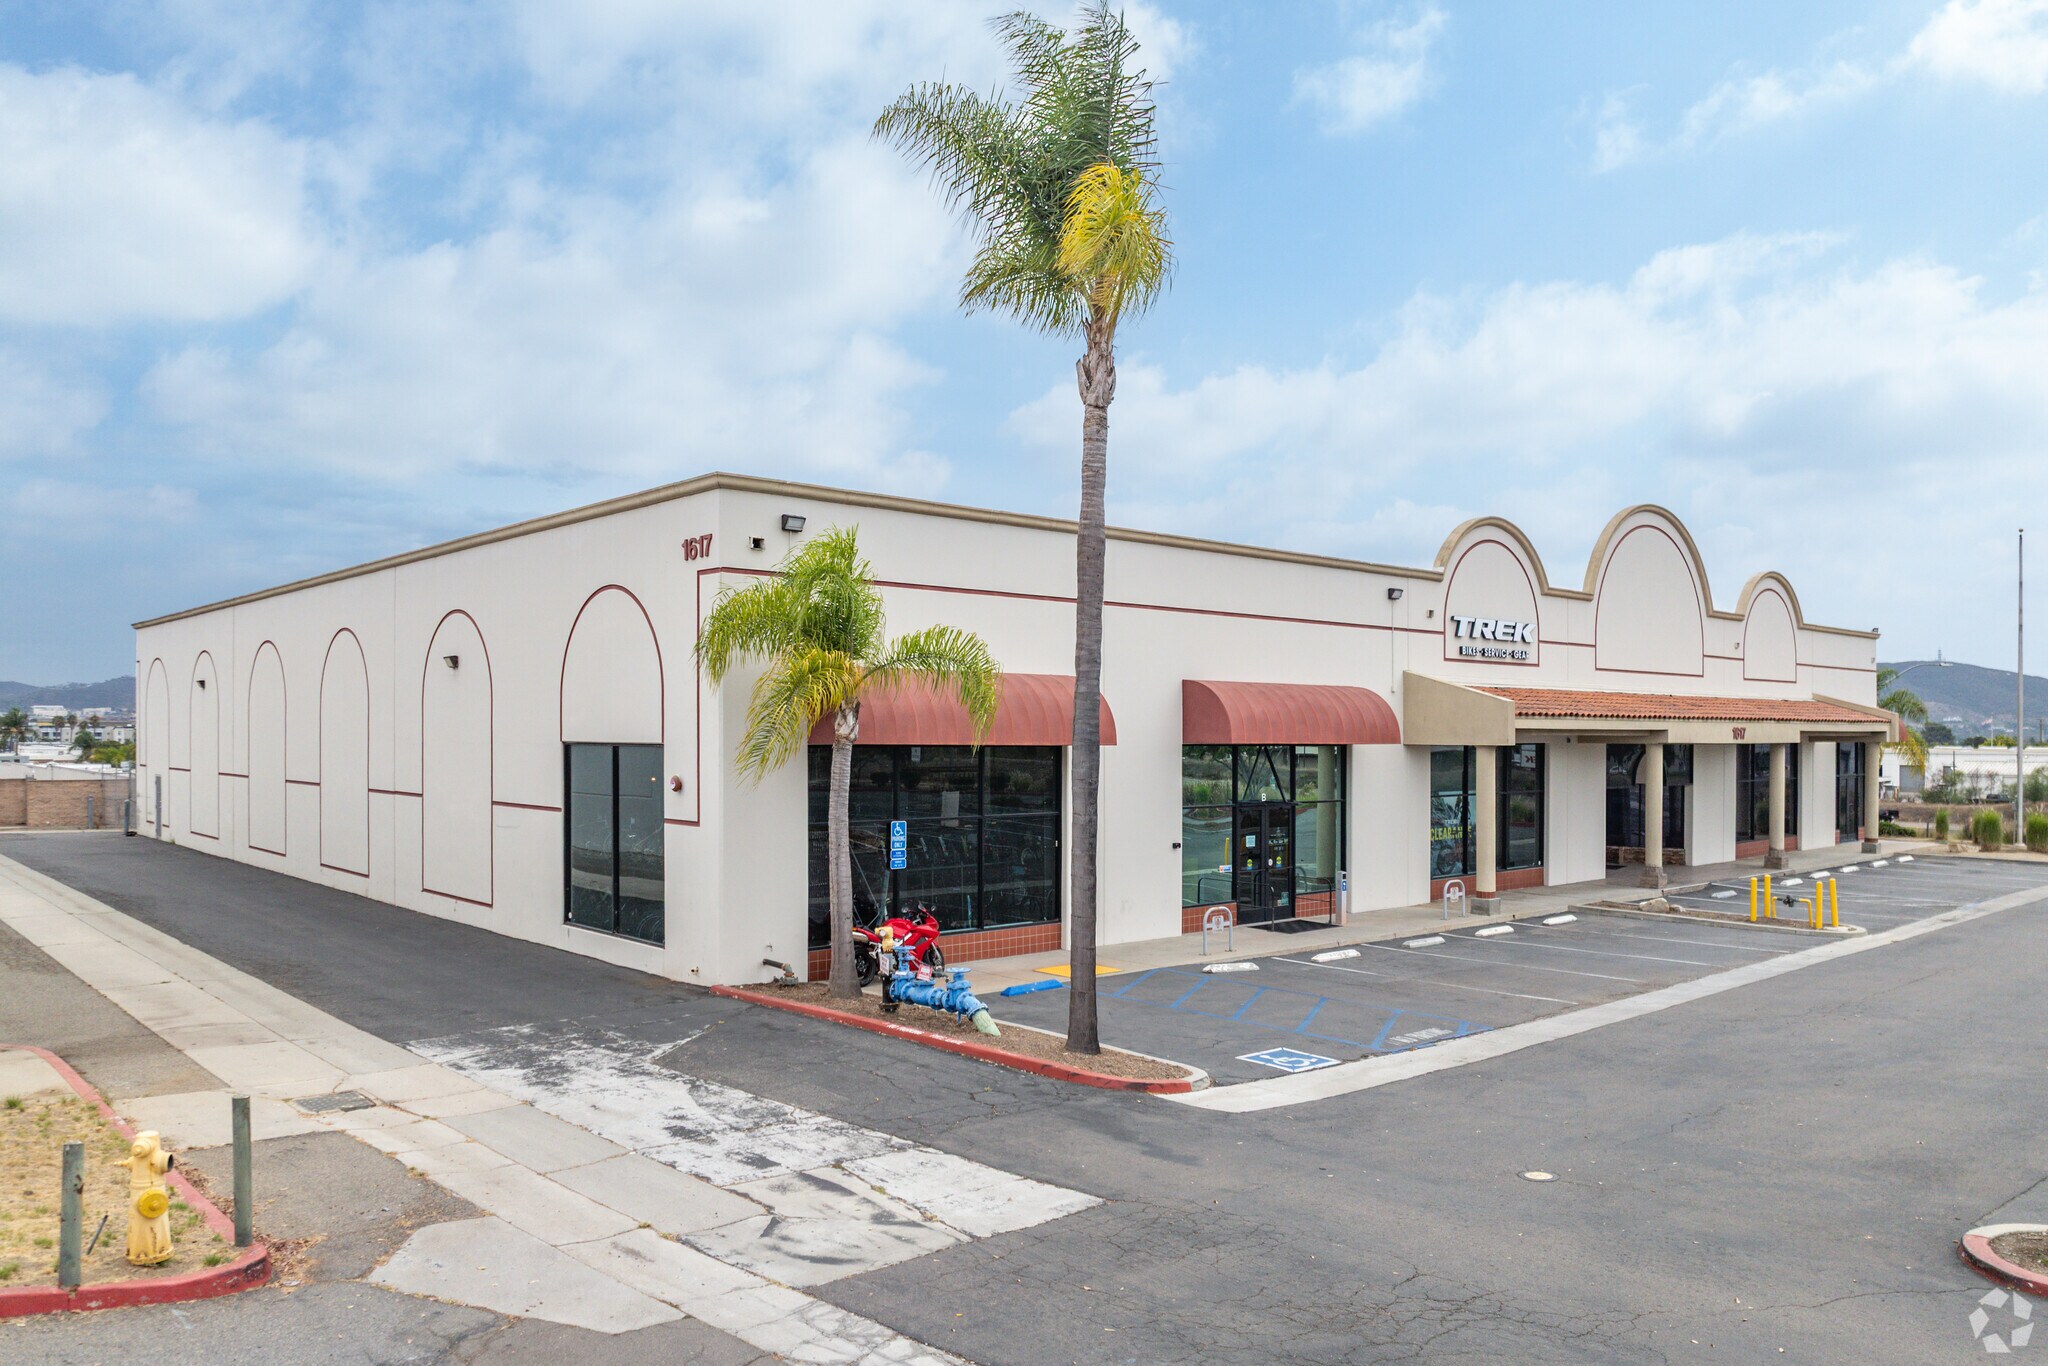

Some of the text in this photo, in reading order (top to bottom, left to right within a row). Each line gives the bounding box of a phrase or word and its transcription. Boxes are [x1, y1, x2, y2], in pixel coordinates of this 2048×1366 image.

[681, 533, 713, 561] 1617
[1451, 615, 1536, 643] TREK
[1460, 646, 1479, 656] BIKES
[1483, 648, 1509, 658] SERVICE
